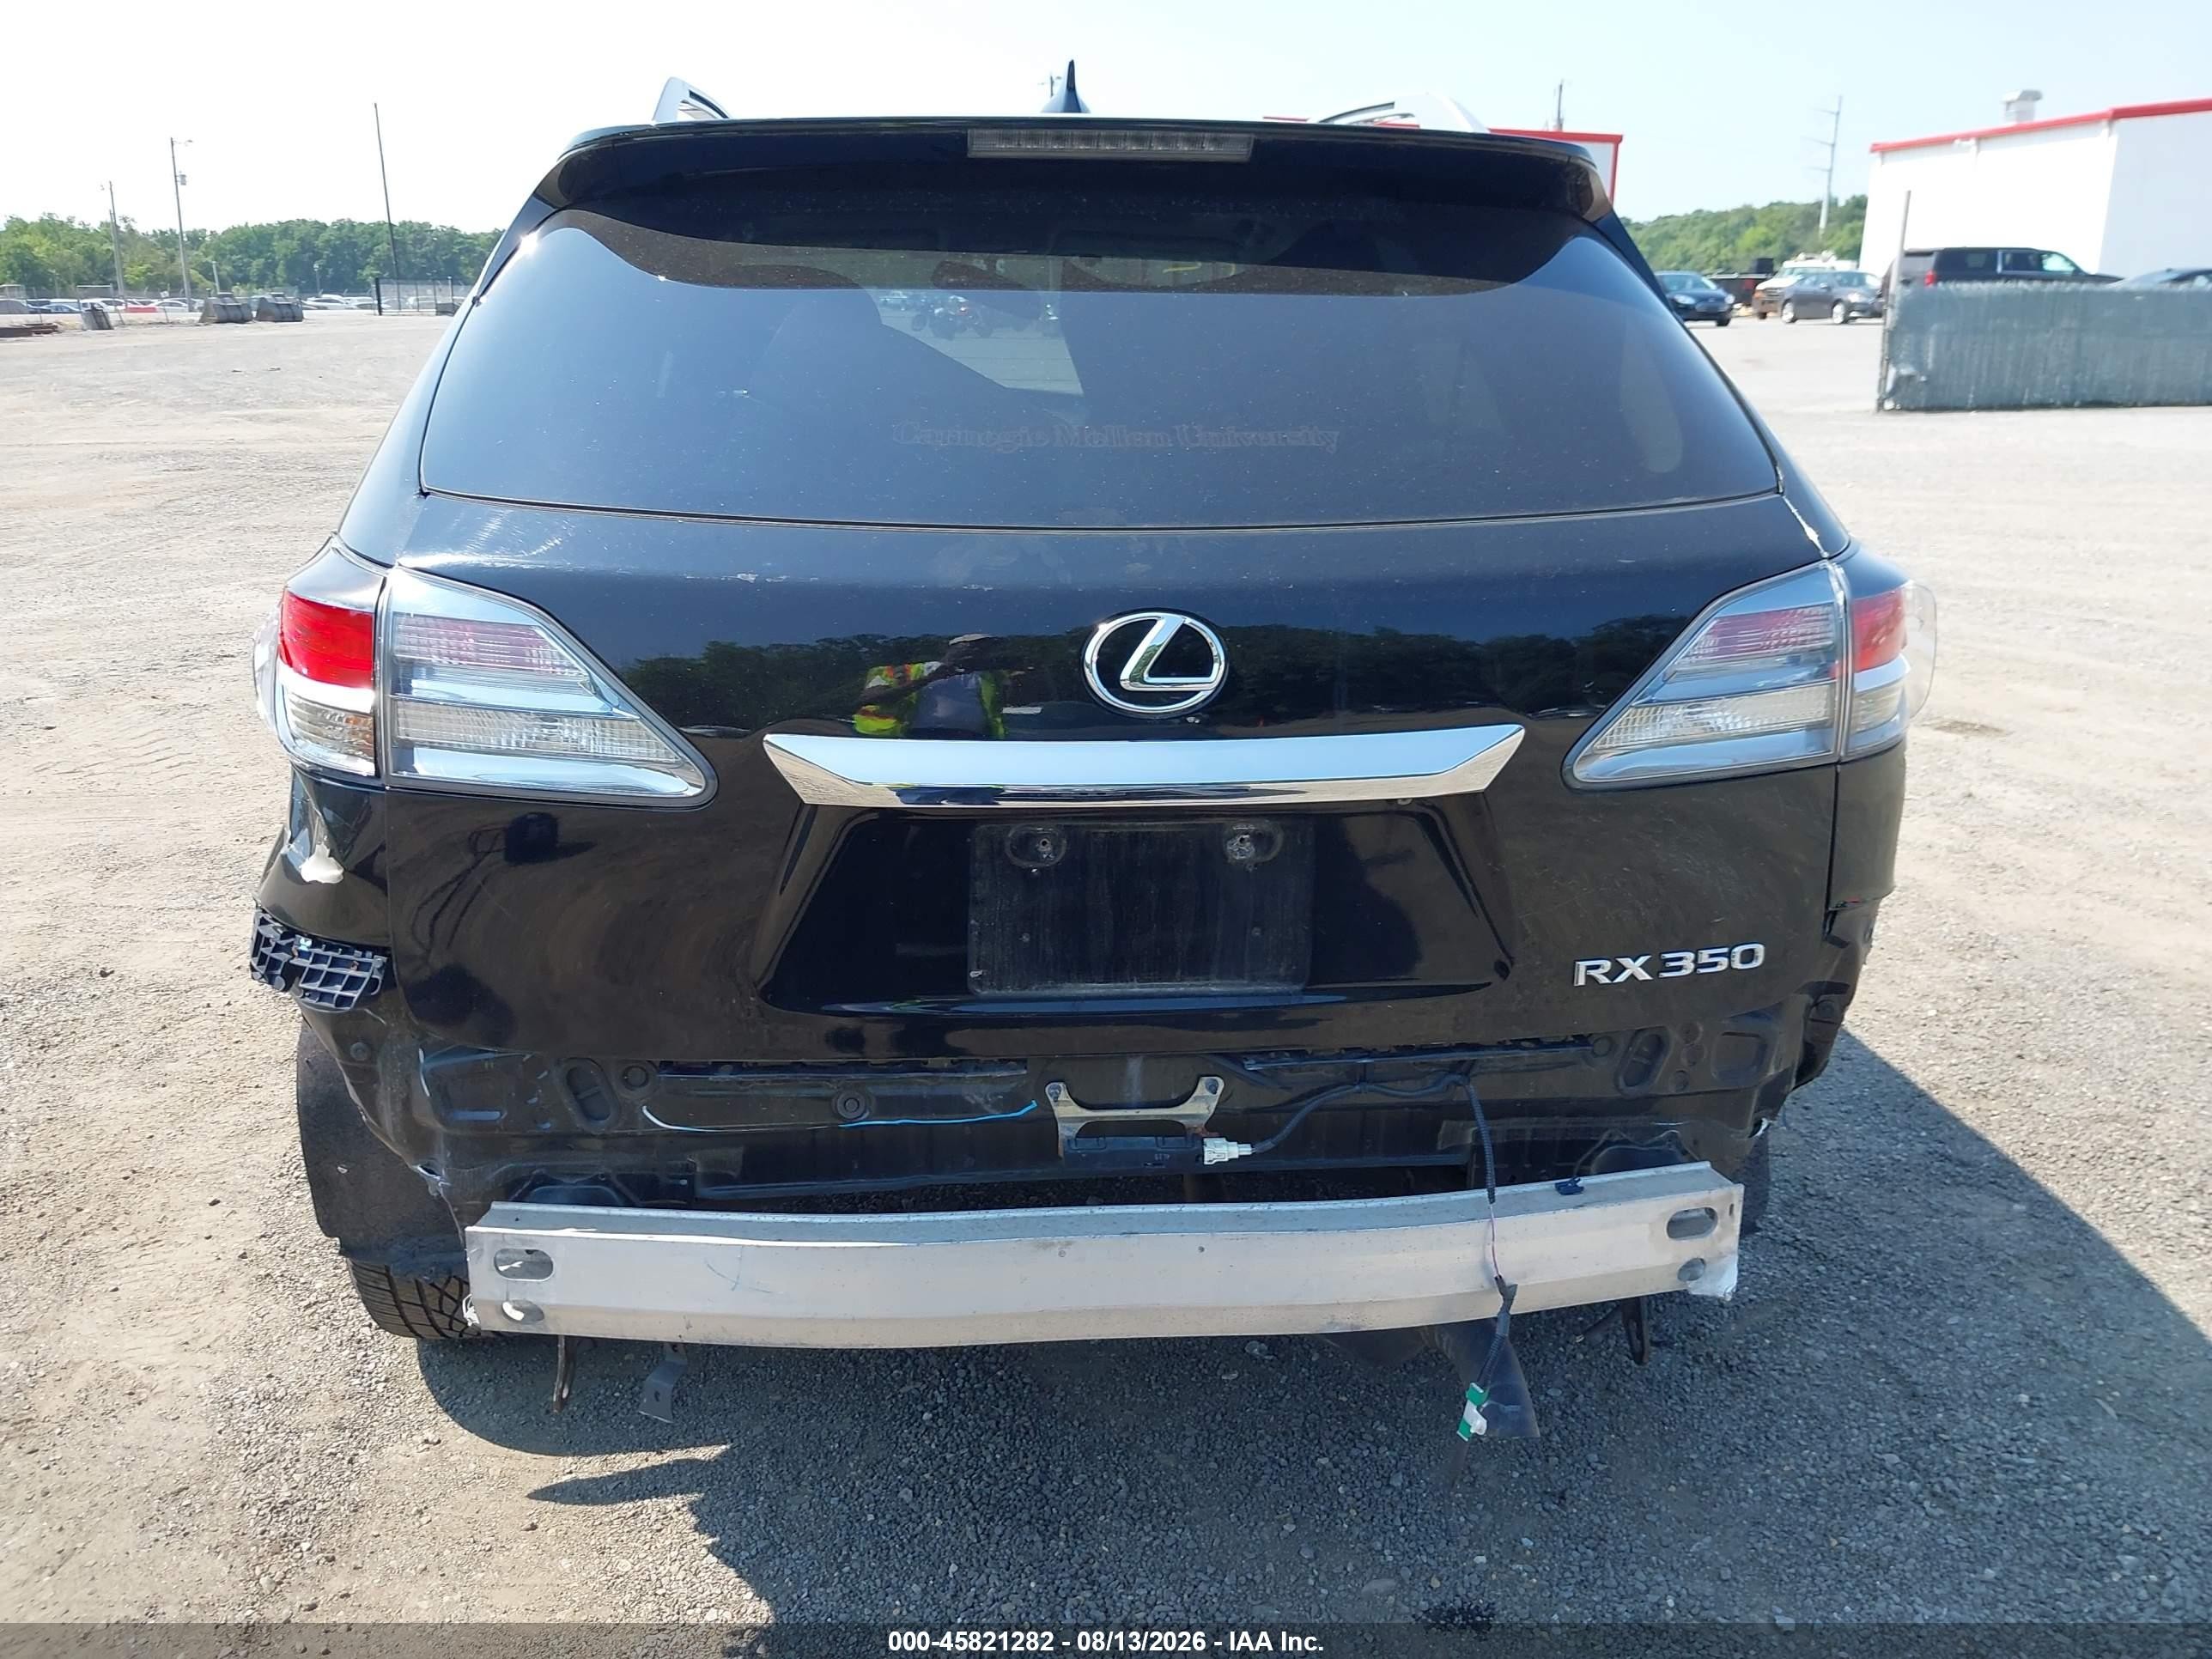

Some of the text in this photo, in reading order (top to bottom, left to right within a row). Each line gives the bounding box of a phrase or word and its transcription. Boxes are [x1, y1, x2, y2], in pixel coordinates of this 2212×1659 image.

[892, 425, 1340, 453] Carnegie Mellon University
[1573, 942, 1765, 987] RX 350
